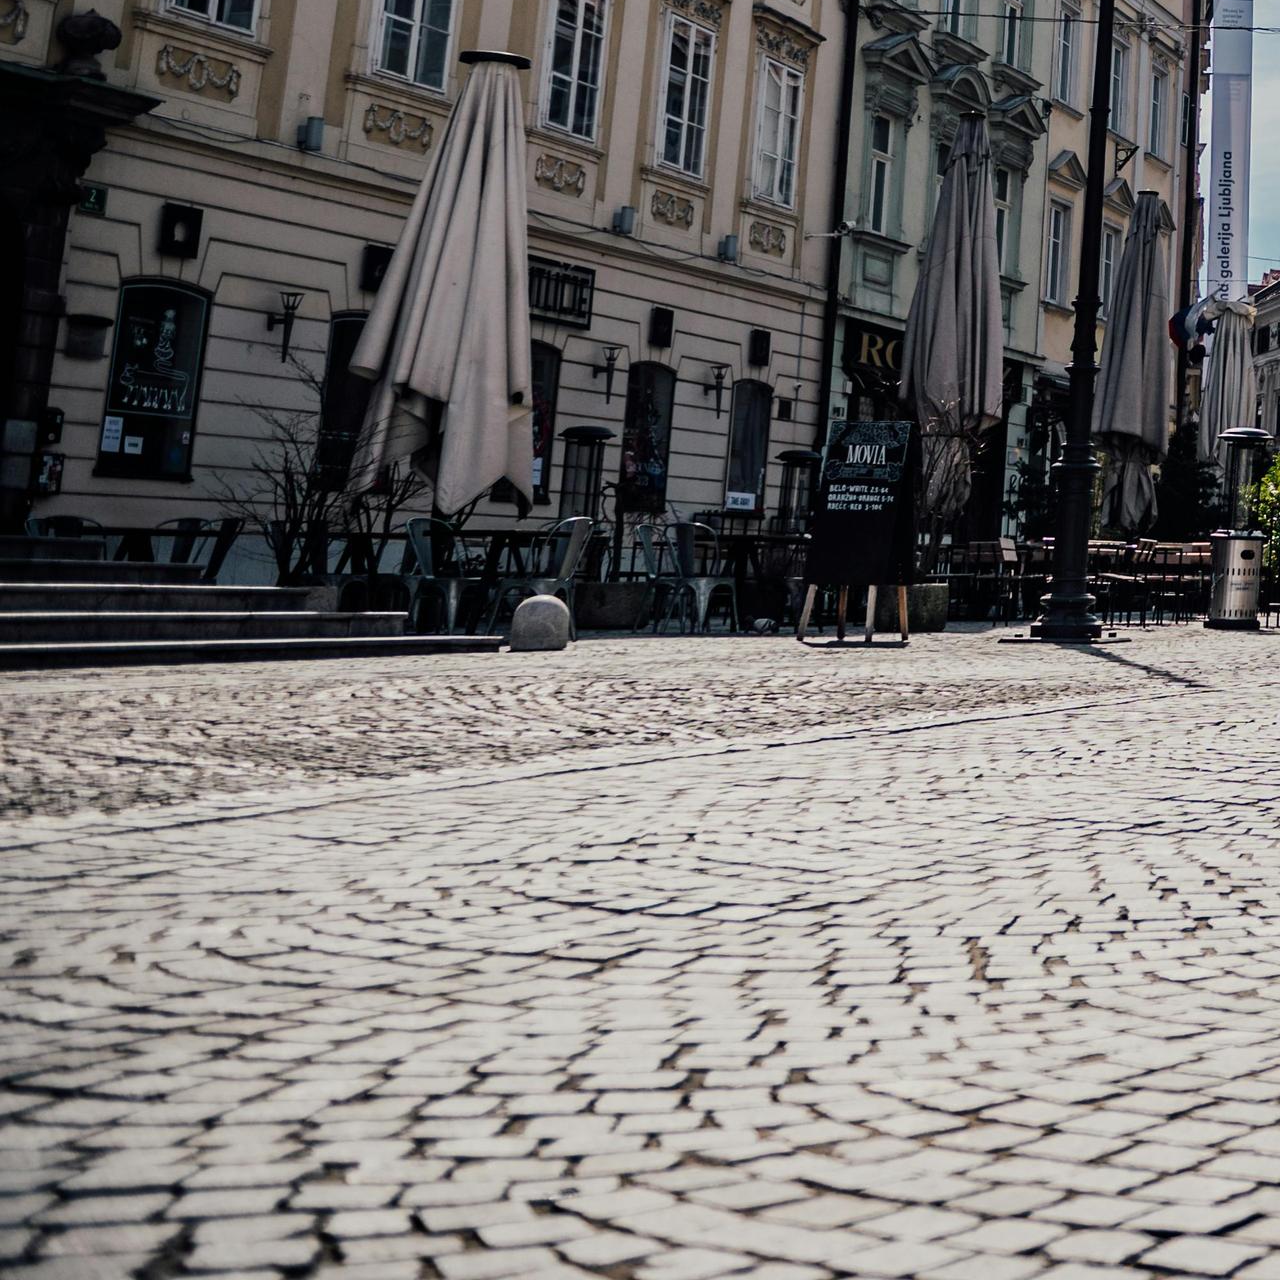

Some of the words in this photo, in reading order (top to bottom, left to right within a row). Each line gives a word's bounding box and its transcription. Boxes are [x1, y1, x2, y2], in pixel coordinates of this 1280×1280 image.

[1219, 151, 1236, 217] Ljubljana
[1216, 223, 1234, 278] galerija
[846, 444, 886, 465] MOVIA
